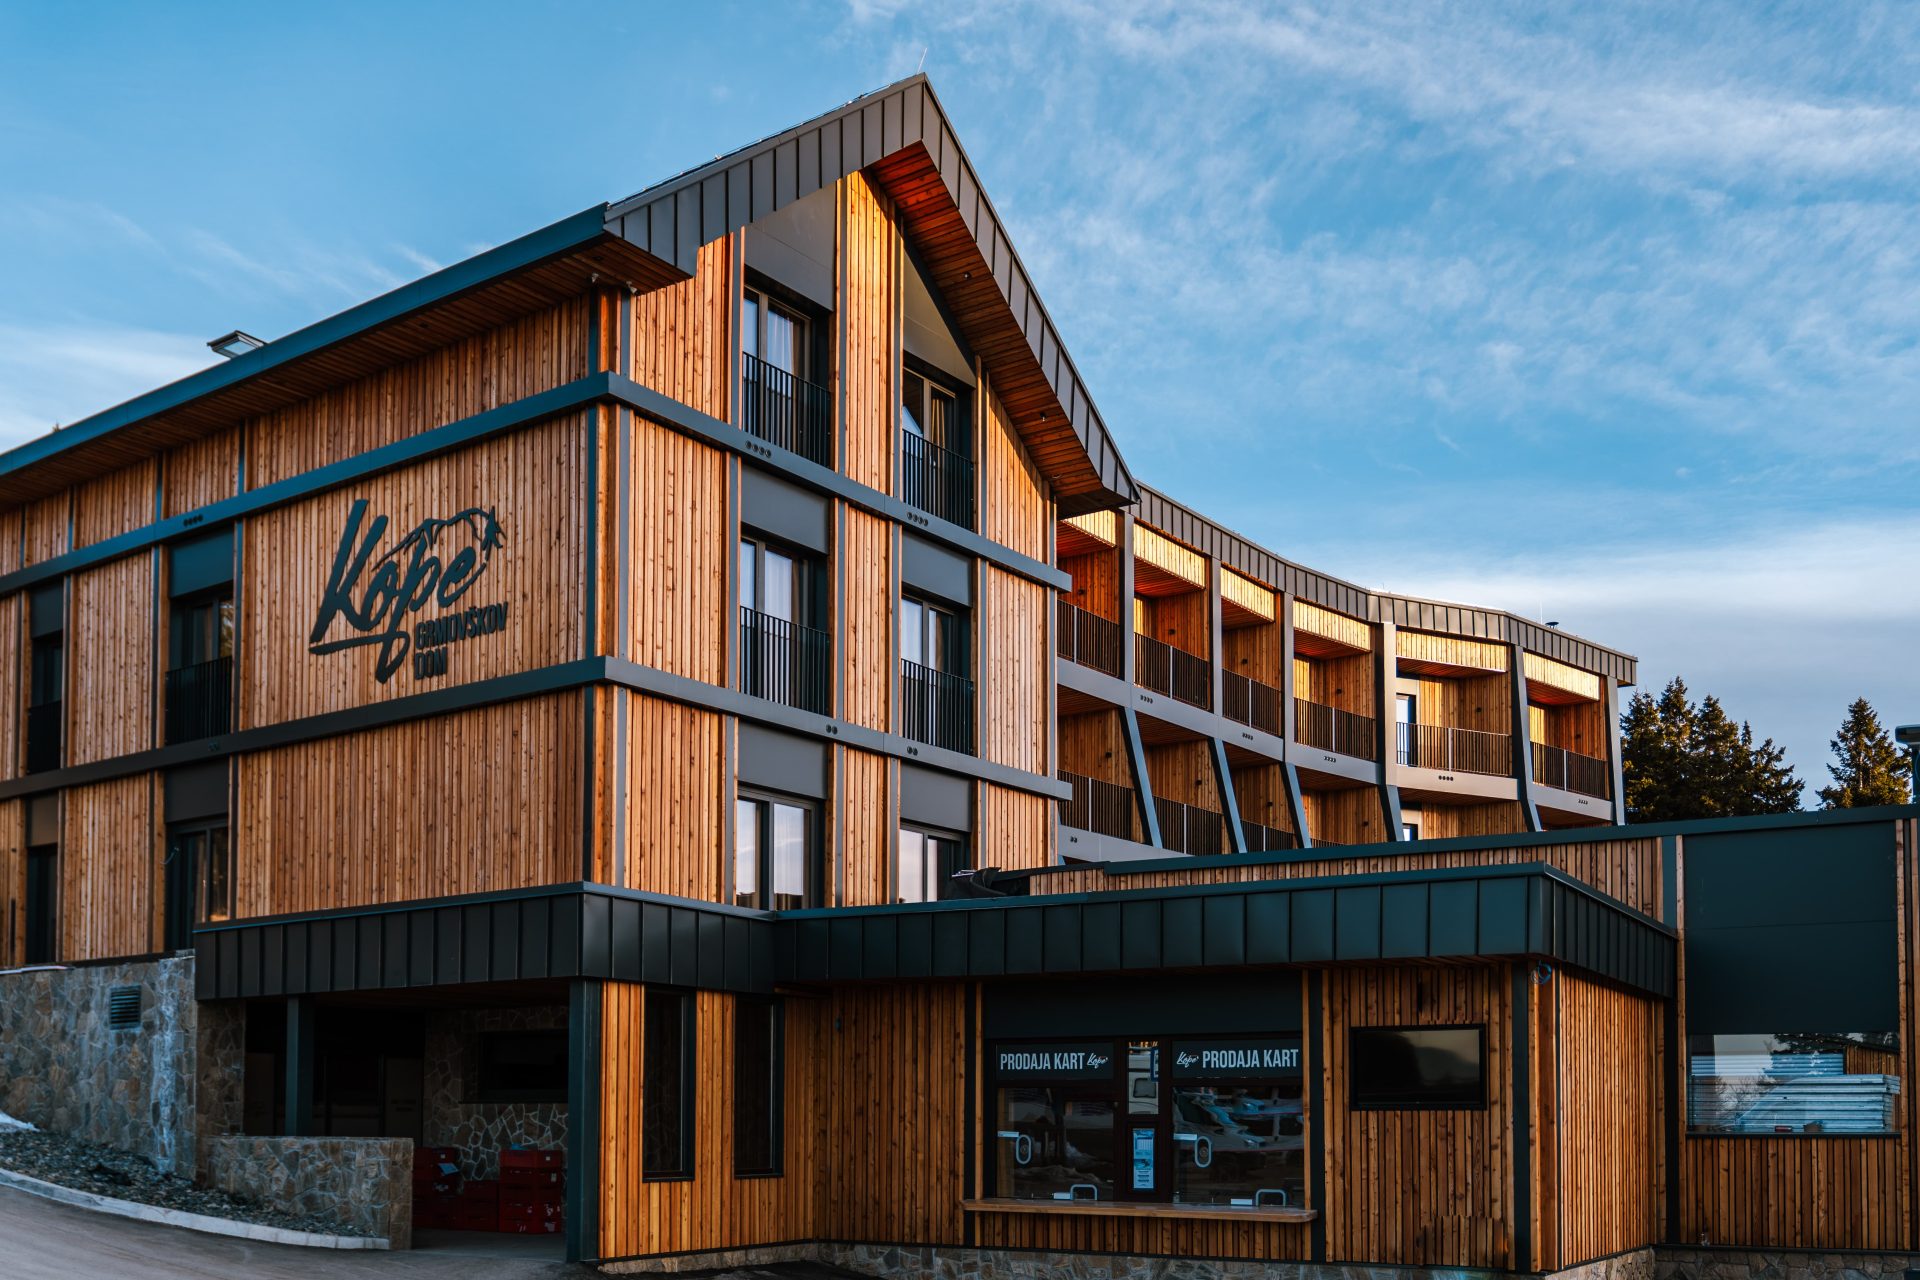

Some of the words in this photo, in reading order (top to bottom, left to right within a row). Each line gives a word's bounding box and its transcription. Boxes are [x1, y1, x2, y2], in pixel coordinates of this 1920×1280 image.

[308, 498, 487, 684] Kope
[416, 601, 508, 650] GRMOVŠKOV
[415, 647, 448, 680] DOM
[1000, 1053, 1051, 1070] PRODAJA
[1054, 1052, 1085, 1070] KART
[1202, 1050, 1260, 1068] PRODAJA
[1263, 1049, 1299, 1067] KART
